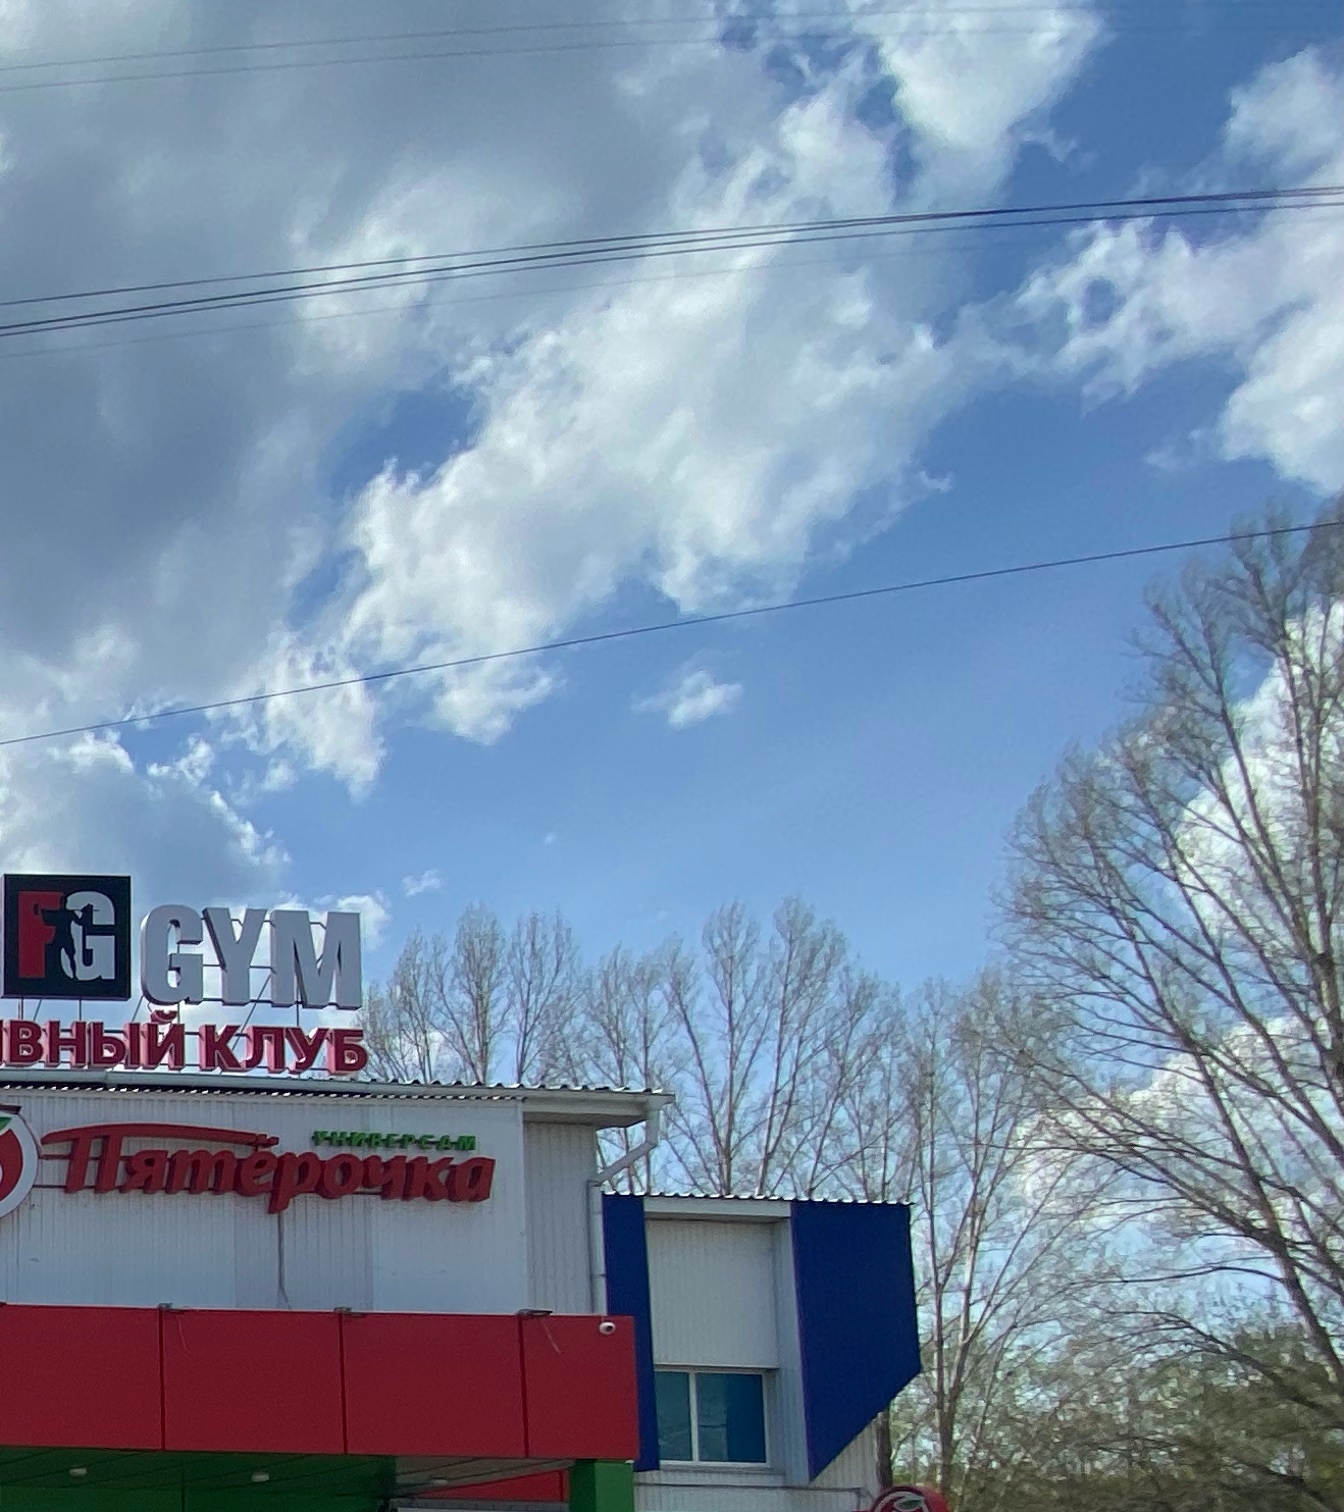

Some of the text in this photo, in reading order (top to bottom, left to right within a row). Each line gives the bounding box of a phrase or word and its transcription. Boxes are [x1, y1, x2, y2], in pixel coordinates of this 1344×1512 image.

[140, 904, 363, 1010] GYM
[201, 1024, 369, 1075] КЛУБ
[313, 1130, 476, 1151] УНИВЕРСАМ
